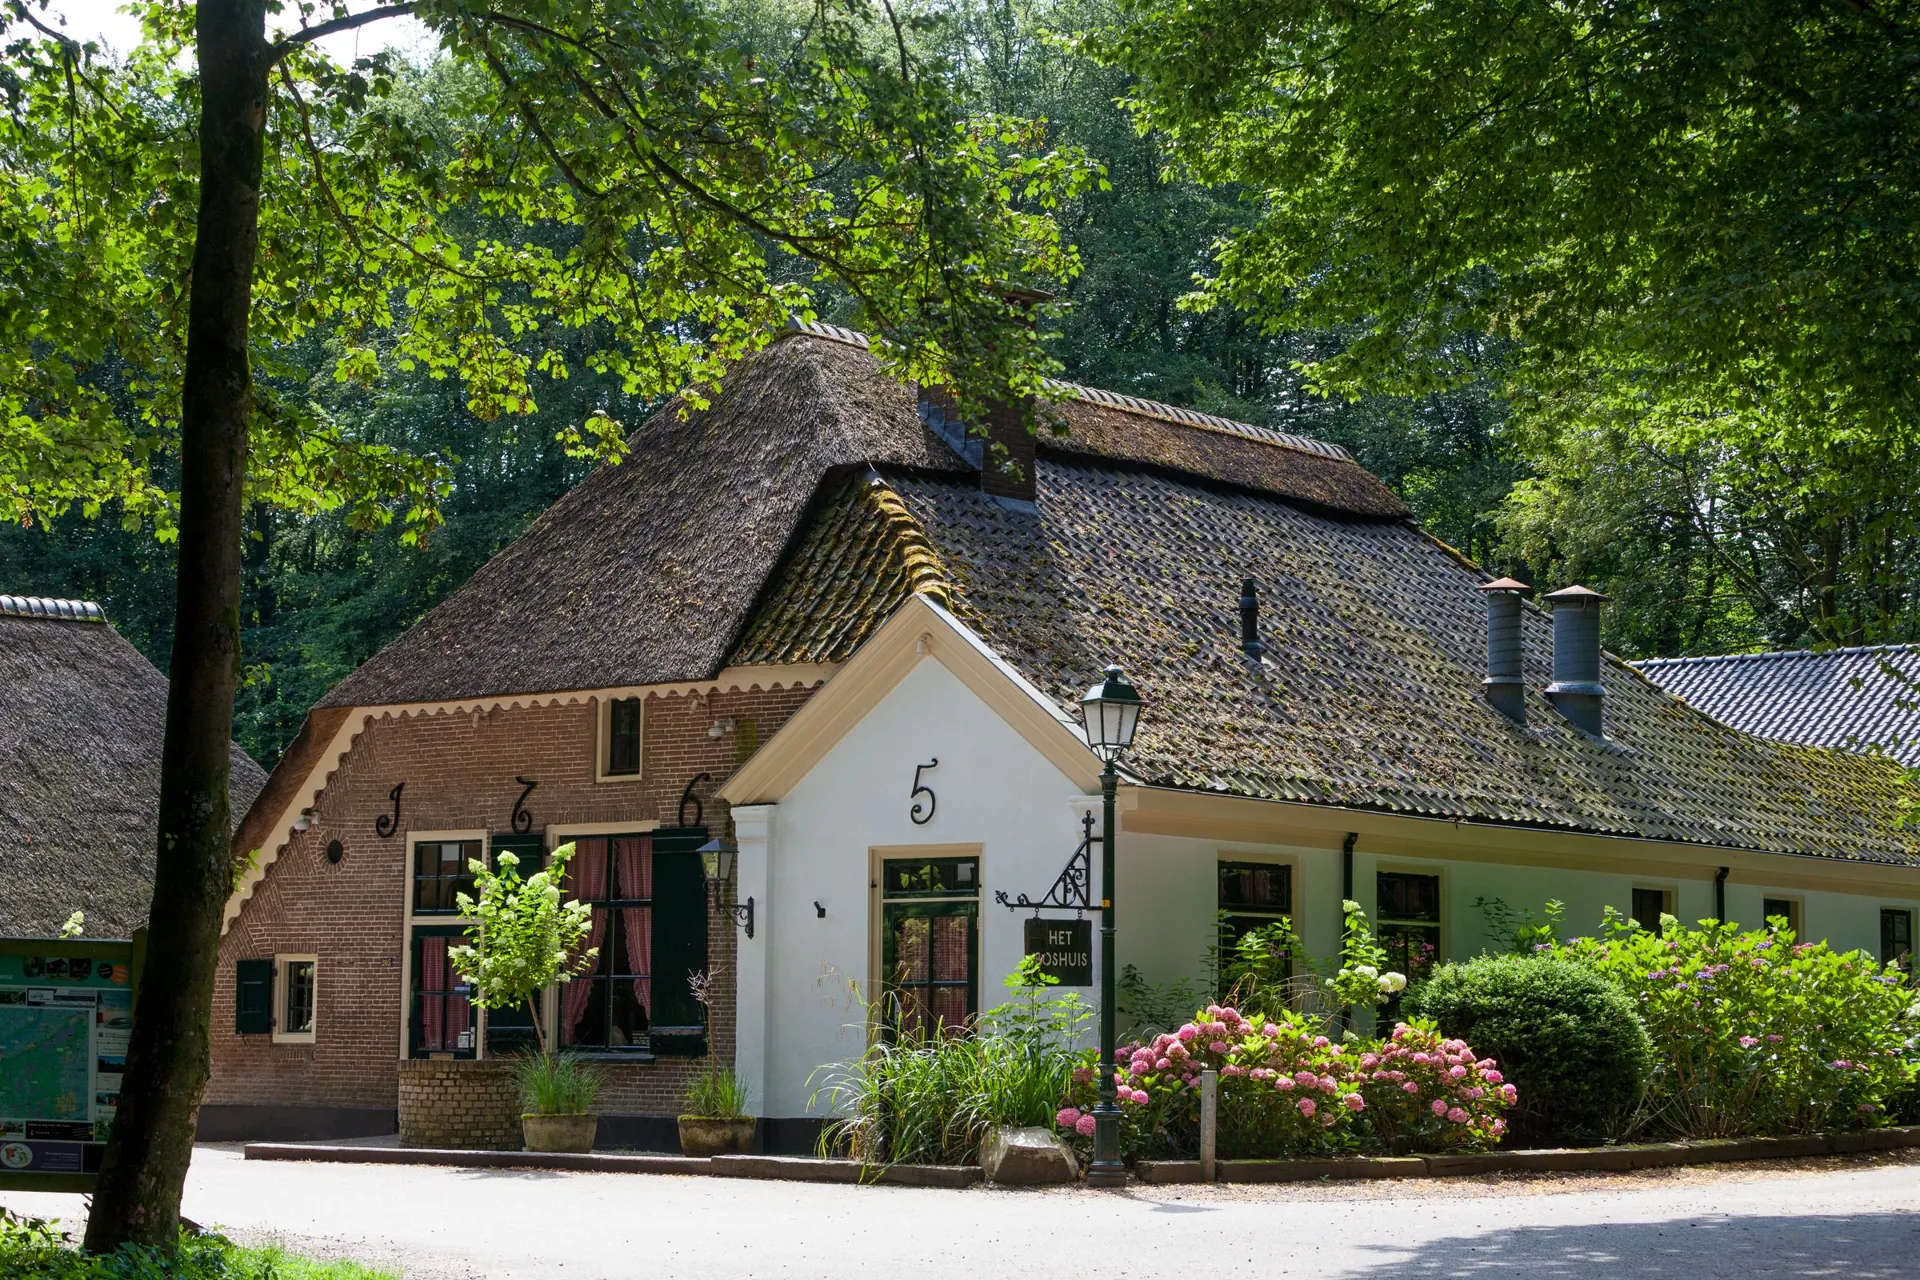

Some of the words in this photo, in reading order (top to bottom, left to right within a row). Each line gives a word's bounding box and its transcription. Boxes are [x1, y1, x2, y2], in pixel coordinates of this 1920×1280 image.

[679, 772, 710, 827] 6
[910, 758, 938, 826] 5
[1048, 929, 1073, 946] HET
